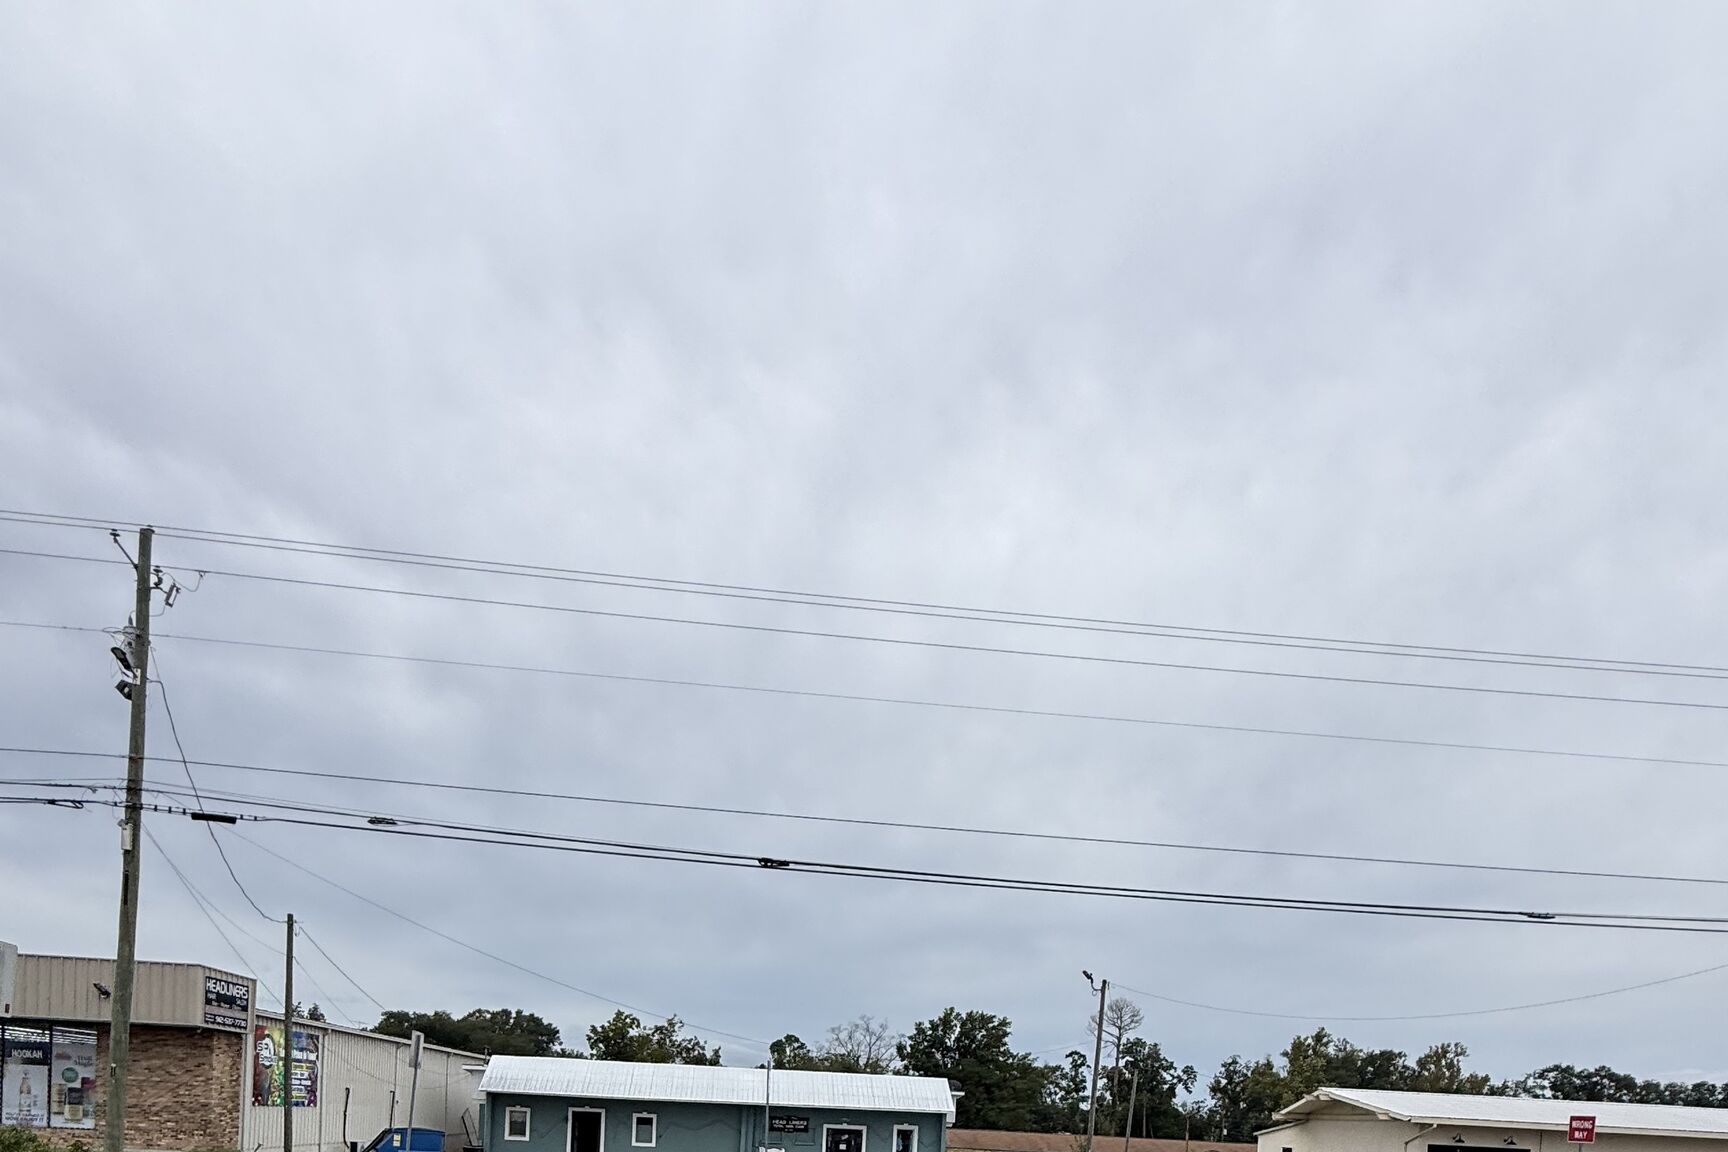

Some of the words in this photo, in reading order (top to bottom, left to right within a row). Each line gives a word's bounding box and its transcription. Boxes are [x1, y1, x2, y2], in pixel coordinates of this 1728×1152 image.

[206, 978, 248, 999] HEADLINERS
[11, 1048, 43, 1059] HOOKAH
[1571, 1120, 1594, 1129] WRONG
[1574, 1130, 1588, 1139] WAY
